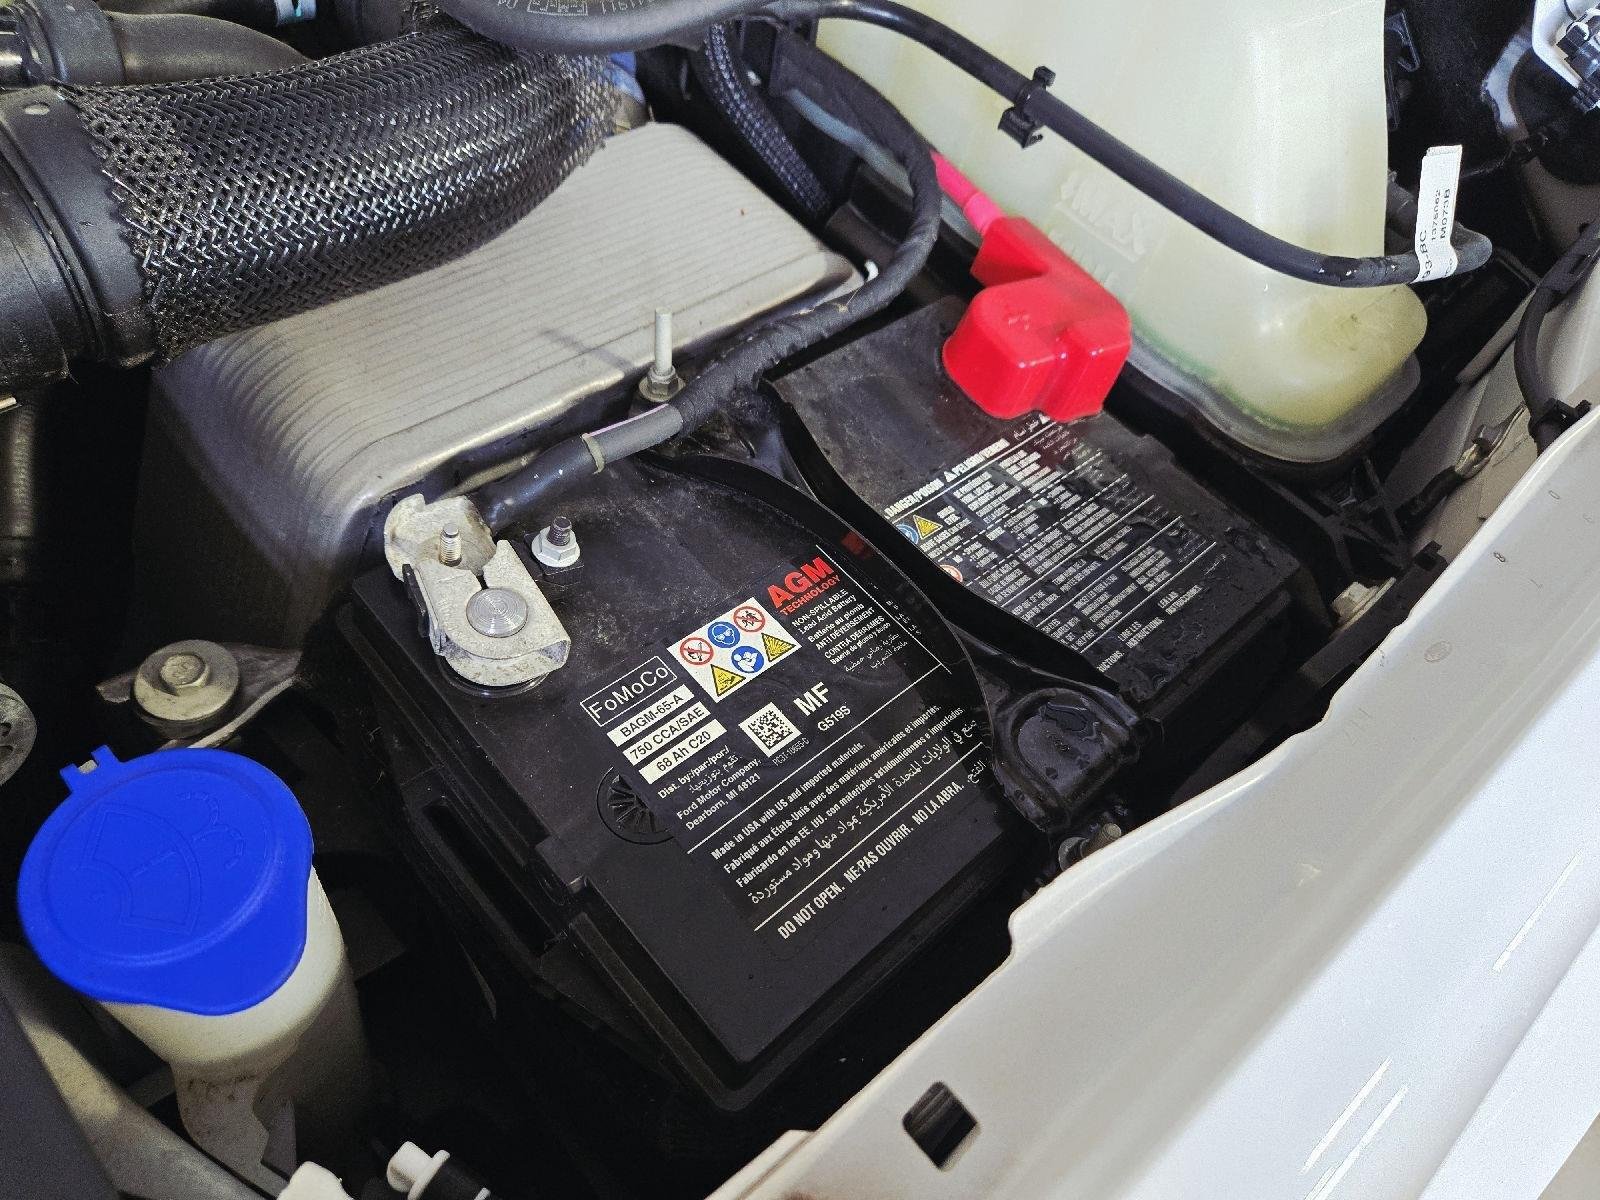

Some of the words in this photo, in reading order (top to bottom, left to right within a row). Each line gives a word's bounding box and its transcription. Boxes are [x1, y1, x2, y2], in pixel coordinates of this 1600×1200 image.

[767, 556, 835, 609] AGM
[779, 574, 841, 616] TECHNOLOGY
[791, 588, 849, 628] NON-SPILLABLE
[797, 619, 818, 635] Lead
[816, 608, 834, 623] Acid
[830, 594, 857, 613] Battery
[807, 623, 836, 643] Batterie
[834, 616, 845, 626] au
[843, 603, 865, 621] plomb
[815, 635, 833, 651] ANTI
[829, 606, 875, 640] DÉVERSEMENT
[824, 637, 853, 659] CONTRA
[849, 615, 885, 641] DERRAMES
[849, 644, 858, 652] de
[587, 667, 669, 719] FoMoCo
[792, 681, 829, 717] MF
[619, 694, 684, 738] BAGM-65-A
[629, 741, 653, 760] 750
[652, 706, 705, 745] CCA/SAE
[817, 705, 851, 732] G519S
[656, 757, 673, 772] 68
[672, 747, 690, 763] Ah
[688, 730, 711, 749] C20
[921, 735, 953, 765] الولايات
[950, 730, 964, 745] في
[657, 783, 681, 799] Dist.
[676, 801, 699, 820] Ford
[695, 784, 722, 805] Motor
[720, 758, 762, 787] Company,
[891, 760, 923, 788] المتحدة
[685, 799, 729, 831] Dearborn,
[725, 788, 739, 801] MI
[737, 772, 761, 792] 48121
[710, 840, 736, 860] Made
[732, 833, 745, 843] in
[741, 820, 762, 837] USA
[758, 808, 778, 824] with
[774, 798, 789, 811] US
[787, 787, 803, 803] and
[799, 764, 833, 792] imported
[831, 742, 866, 769] materials.
[723, 843, 760, 874] Fabriqué
[757, 833, 775, 848] aux
[770, 805, 811, 837] États-Unis
[808, 791, 827, 809] avec
[825, 781, 840, 795] des
[837, 757, 873, 785] matériaux
[870, 731, 907, 761] américains
[904, 724, 914, 734] et
[735, 853, 779, 888] Fabricardo
[777, 845, 789, 857] en
[785, 835, 801, 849] los
[797, 825, 814, 839] EE.
[810, 814, 828, 829] UU.
[825, 803, 841, 817] con
[838, 776, 876, 807] materiales
[873, 736, 927, 779] estadounidenses
[924, 732, 931, 740] e
[855, 782, 895, 817] الأمريكية
[814, 833, 838, 849] منها
[837, 814, 862, 834] بمواد
[777, 920, 797, 940] DO
[792, 902, 817, 927] NOT
[813, 881, 846, 909] OPEN.
[874, 823, 914, 857] OUVRIR.
[911, 809, 929, 826] NO
[923, 799, 941, 815] LA
[935, 781, 965, 806] ABRA.
[791, 848, 821, 871] ومواد
[747, 869, 793, 904] مستوردة
